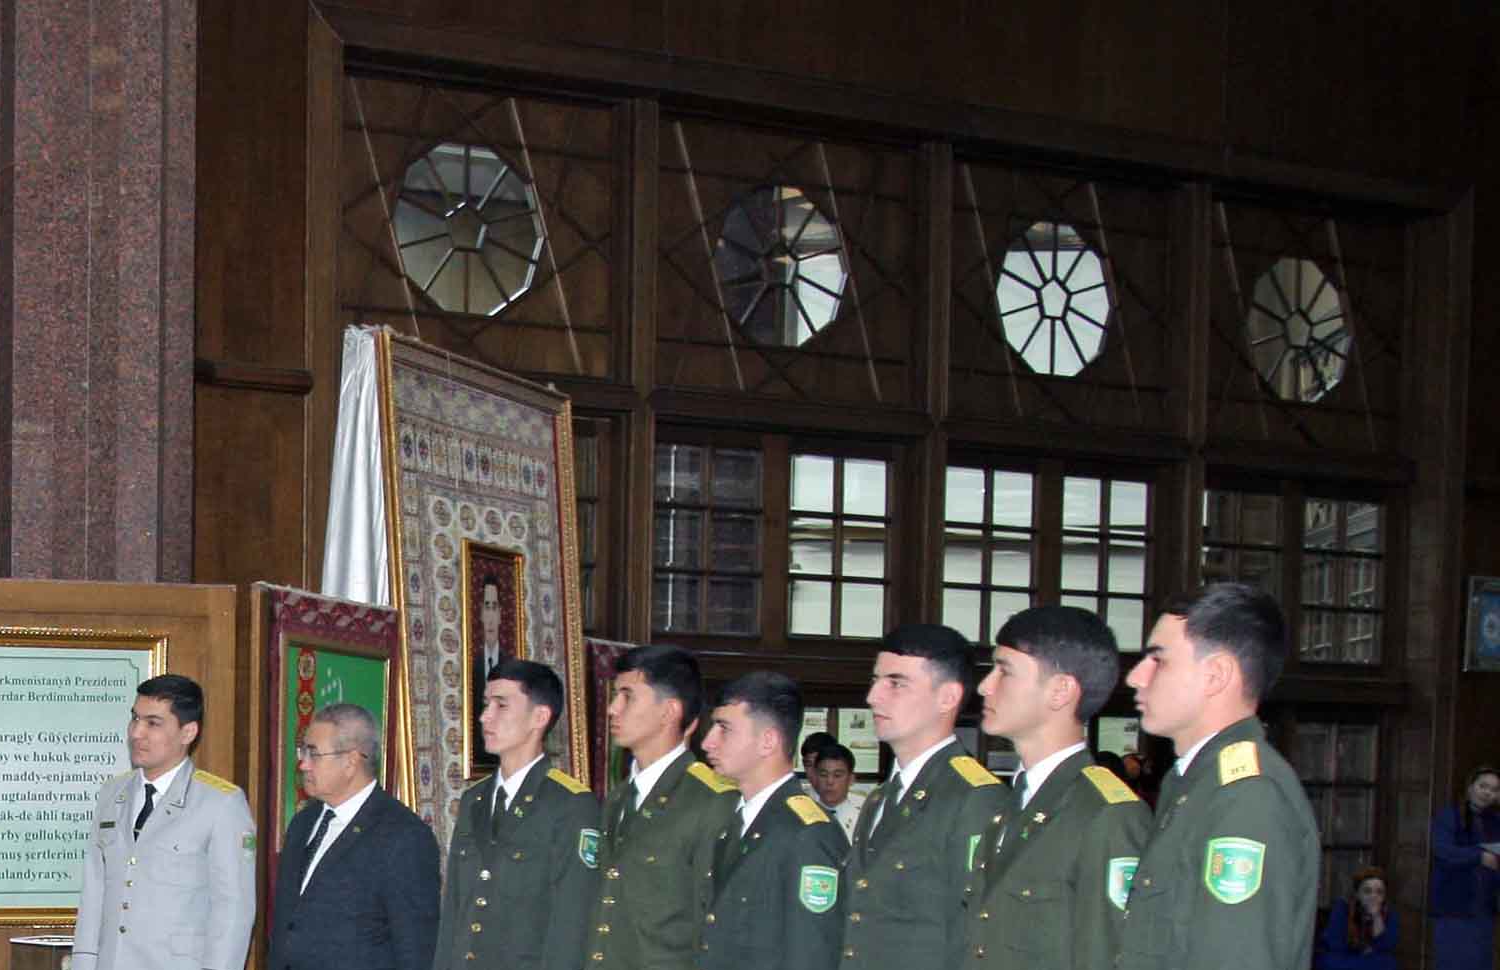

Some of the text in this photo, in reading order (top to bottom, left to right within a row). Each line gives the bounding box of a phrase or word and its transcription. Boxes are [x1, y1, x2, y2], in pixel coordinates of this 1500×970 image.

[74, 676, 127, 687] Prezidenti
[28, 691, 126, 702] Berdimuhamedow:
[14, 754, 30, 762] we
[33, 751, 70, 762] hukuk
[35, 811, 58, 821] ähli
